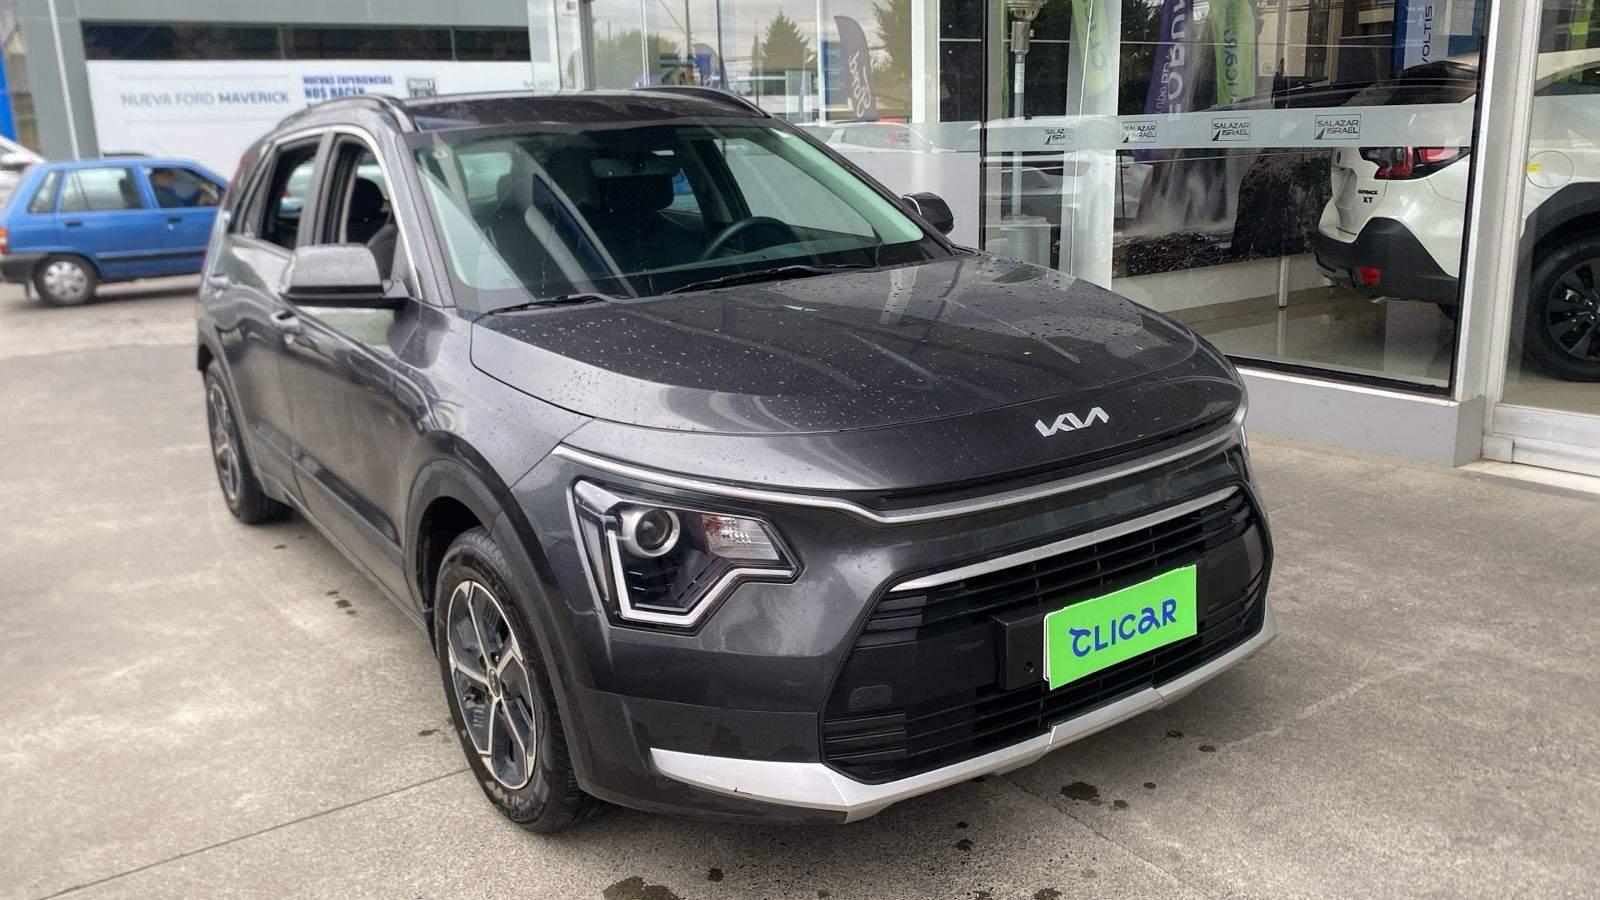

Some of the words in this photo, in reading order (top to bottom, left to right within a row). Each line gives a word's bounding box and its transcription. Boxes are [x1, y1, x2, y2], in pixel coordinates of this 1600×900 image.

[120, 92, 172, 107] NUEVA
[175, 91, 215, 106] FORD
[218, 90, 289, 105] MAVERICK
[1213, 122, 1250, 130] SALAZAR
[1316, 119, 1359, 128] SALAZAR
[1221, 128, 1249, 136] ISRAEL
[1326, 126, 1359, 134] ISRAEL
[1363, 196, 1374, 204] XT
[1035, 406, 1110, 438] KIA
